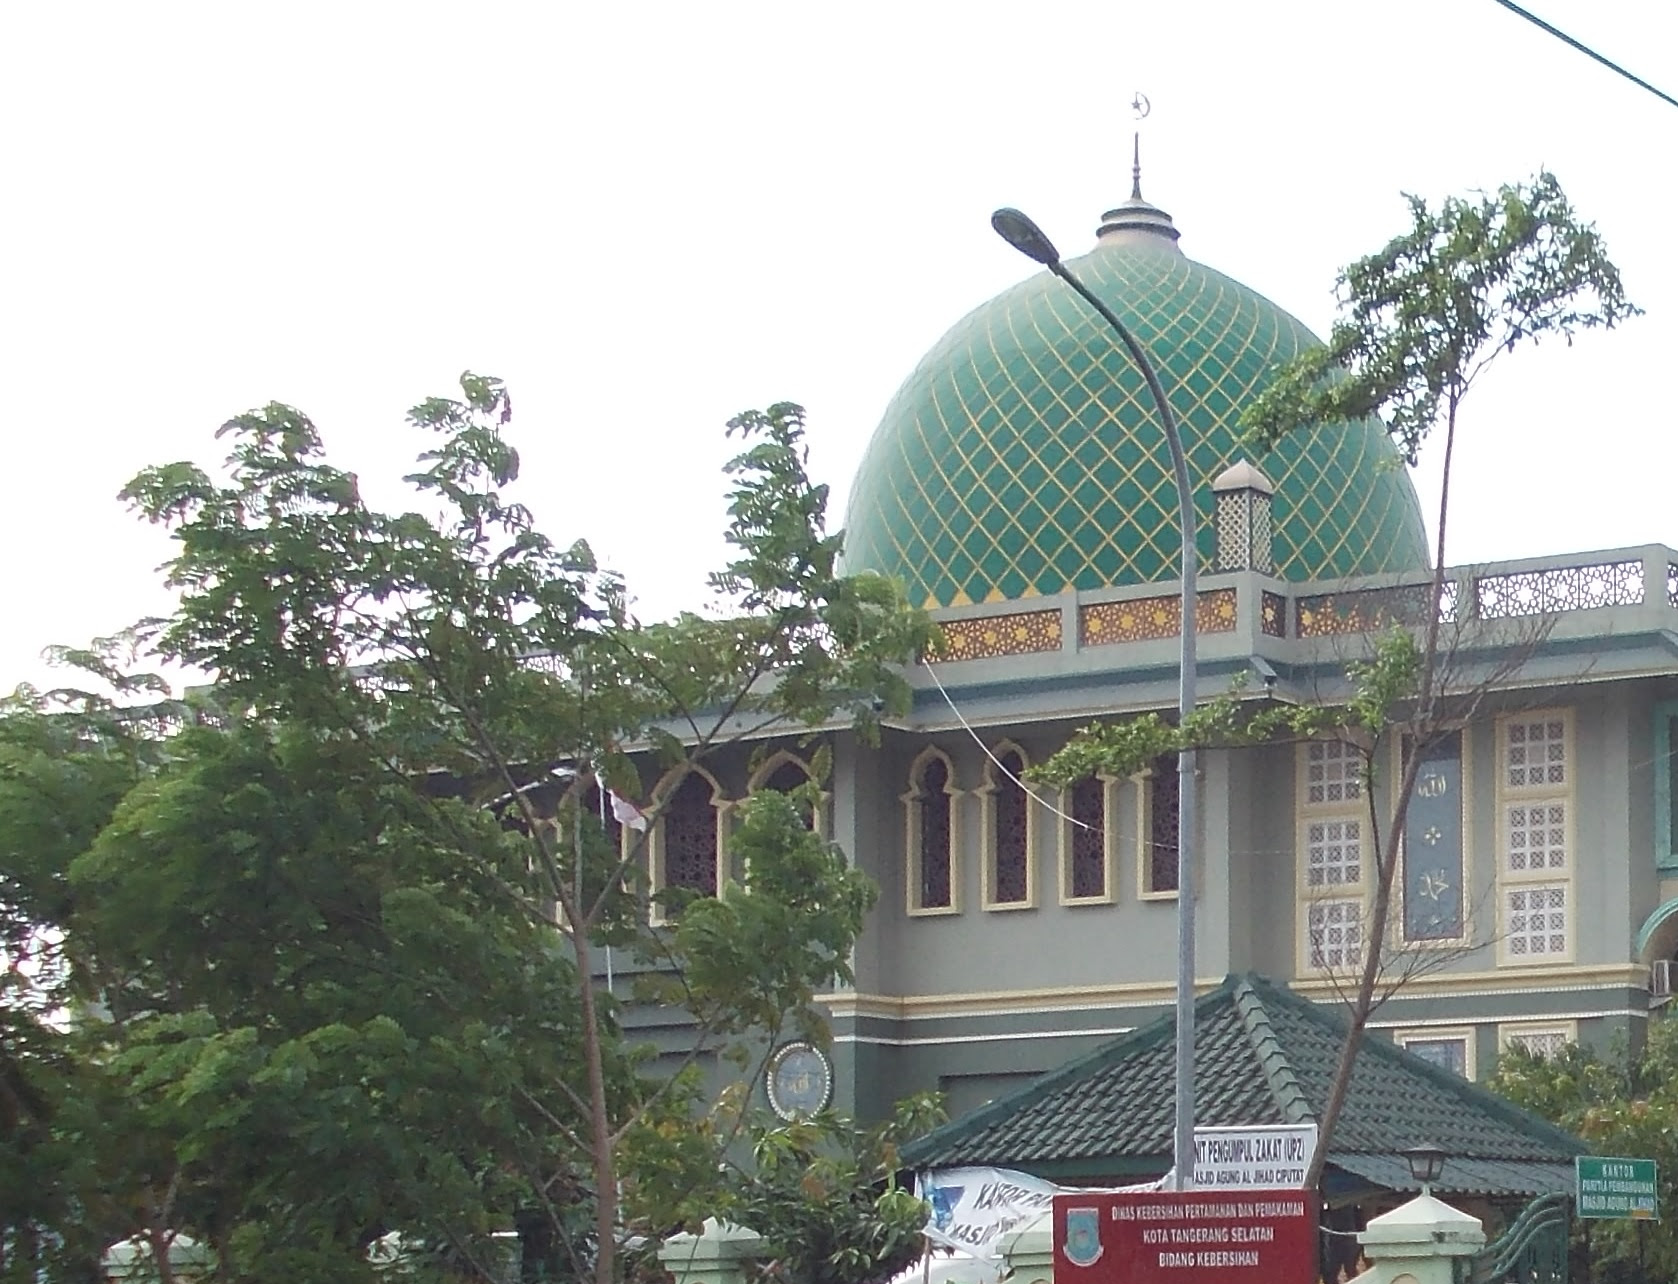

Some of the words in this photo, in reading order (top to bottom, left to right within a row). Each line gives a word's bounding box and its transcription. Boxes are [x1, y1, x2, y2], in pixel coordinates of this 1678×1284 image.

[1208, 1139, 1253, 1163] PENGUMPUL
[1256, 1137, 1281, 1162] ZAKAT
[1194, 1170, 1214, 1184] ASJID
[1276, 1168, 1304, 1183] CIPUTAT
[1112, 1205, 1135, 1220] DINAS
[1137, 1204, 1184, 1220] KEBERSIHAN
[1185, 1203, 1236, 1219] PERTAMANAN
[1238, 1203, 1255, 1218] DAN
[1256, 1201, 1304, 1217] PEMAKAMAN
[1143, 1229, 1168, 1244] KOTA
[1170, 1228, 1229, 1243] TANGERANG
[1231, 1227, 1274, 1242] SELATAN
[1159, 1252, 1195, 1268] BIDANG
[1197, 1251, 1259, 1267] KEBERSIHAN
